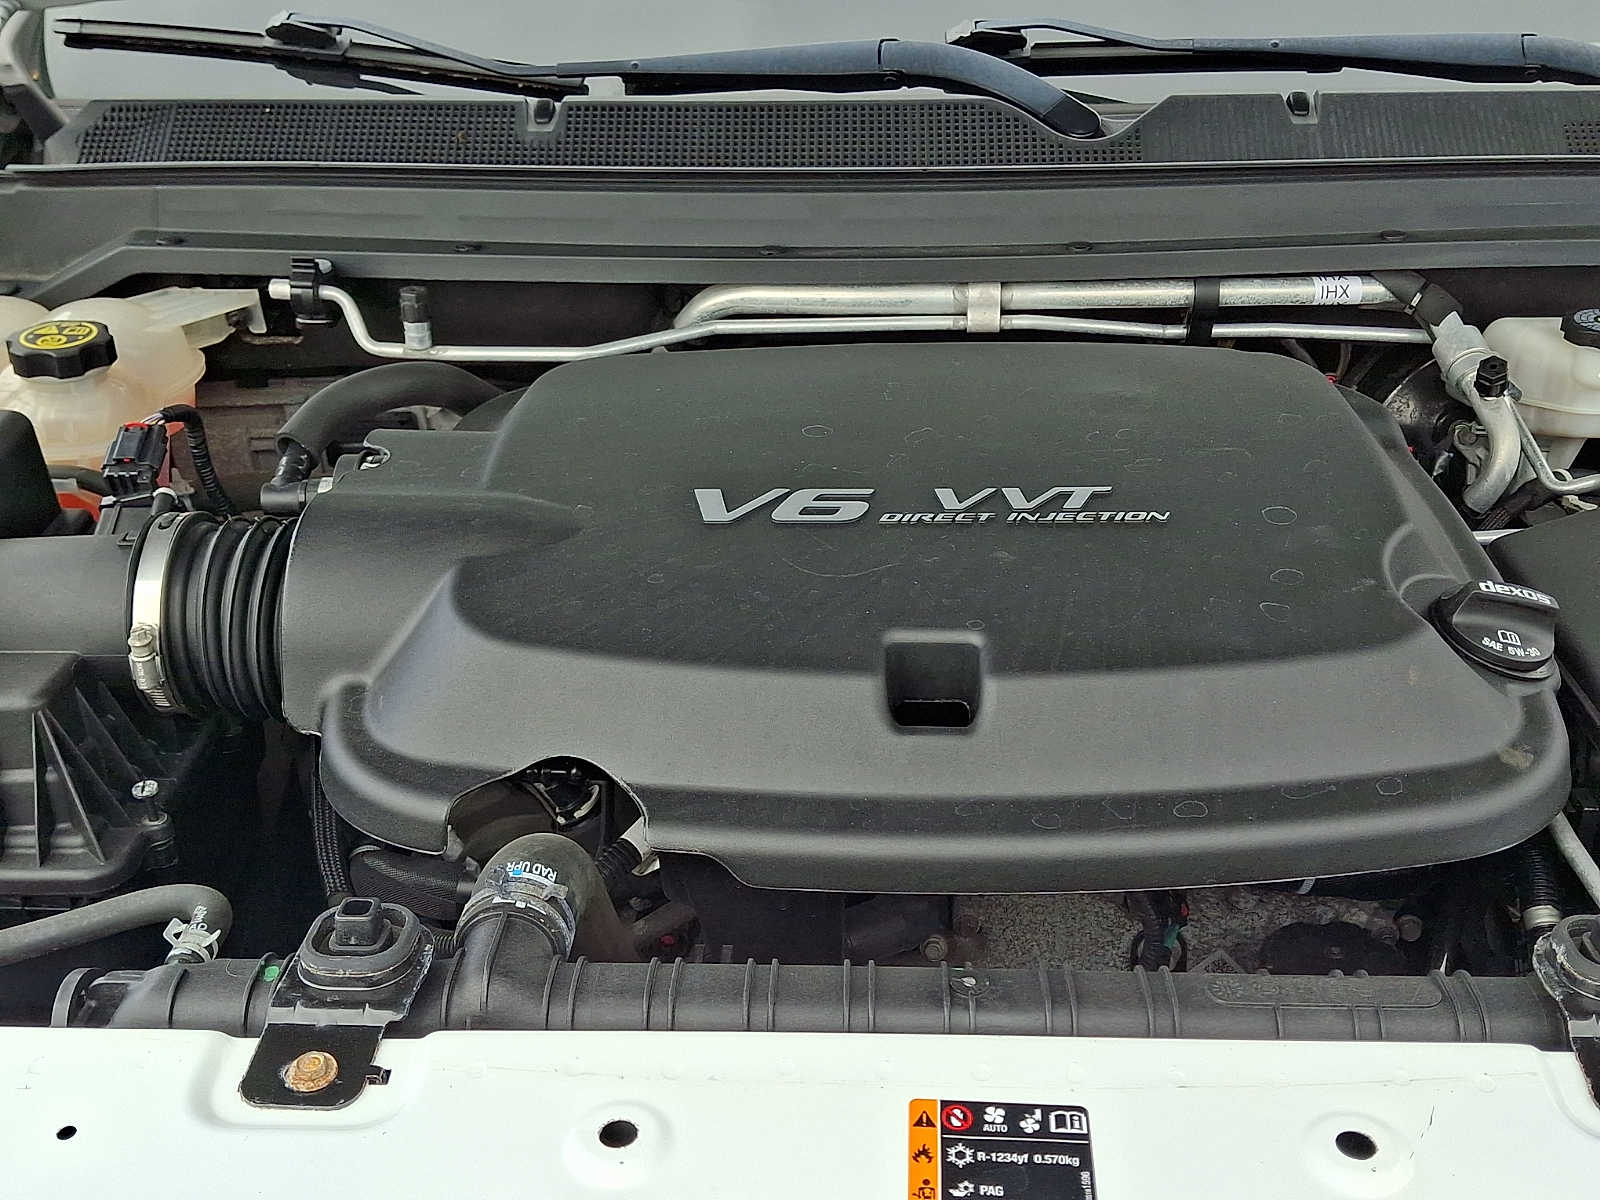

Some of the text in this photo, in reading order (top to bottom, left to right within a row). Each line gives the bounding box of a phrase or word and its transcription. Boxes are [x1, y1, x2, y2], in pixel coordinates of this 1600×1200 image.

[1321, 285, 1350, 299] IHX
[694, 487, 1112, 523] V6 VVT
[879, 511, 1170, 523] DIRECT INJECTION
[1479, 580, 1552, 605] dexos
[1481, 637, 1541, 657] SAE 5W-30
[506, 860, 558, 883] RAD UPR
[982, 1123, 1008, 1133] AUTO
[976, 1151, 1080, 1168] R-1234yf 0.570kg
[979, 1185, 1005, 1196] PAG
